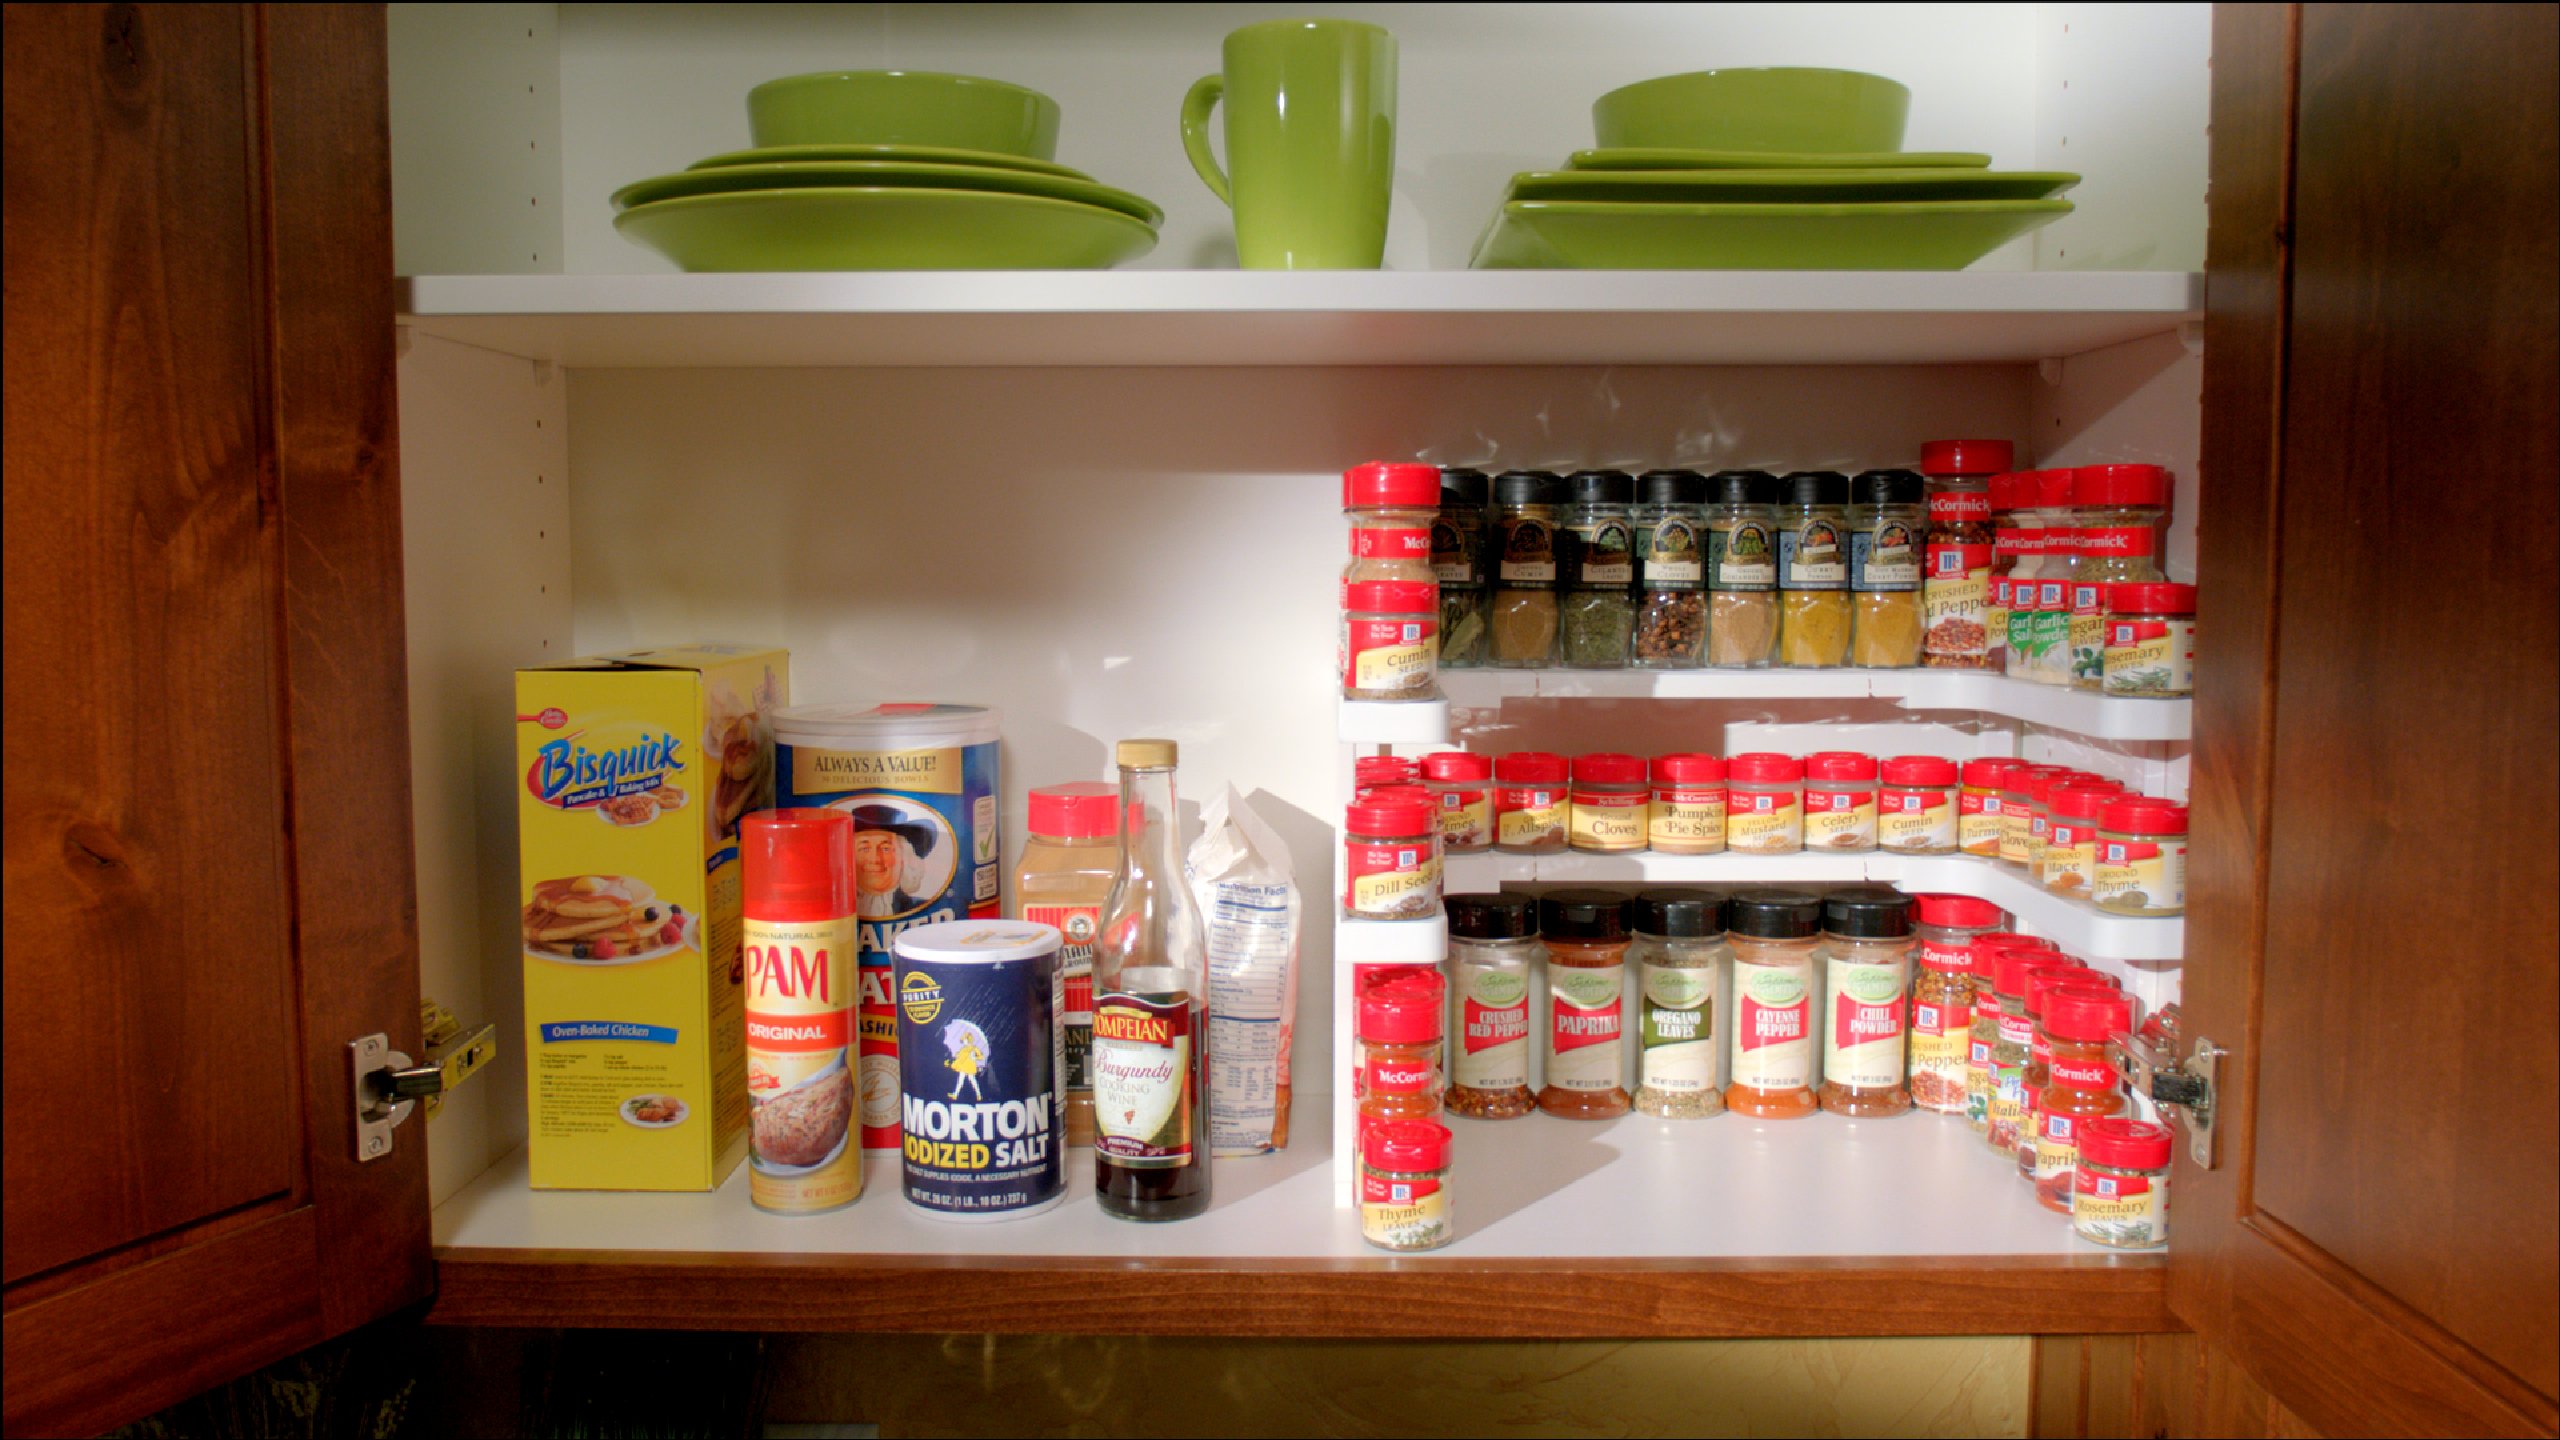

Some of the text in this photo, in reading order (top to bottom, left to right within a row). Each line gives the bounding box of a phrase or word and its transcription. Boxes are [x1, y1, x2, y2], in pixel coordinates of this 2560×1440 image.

[1939, 598, 1989, 617] Peppe
[2013, 629, 2032, 643] Sal
[538, 733, 686, 800] Bisquick
[815, 755, 937, 773] ALWAYS A VALUE!
[831, 774, 891, 785] DELICIOUS
[1592, 819, 1638, 836] Cloves
[1665, 820, 1690, 834] Pie
[1740, 820, 1787, 836] Mustard
[1820, 813, 1861, 828] Celery
[1892, 816, 1934, 830] Cumin
[2001, 830, 2030, 846] Clove
[1375, 879, 1400, 897] Dill
[2097, 878, 2141, 895] Thyme
[745, 944, 829, 1005] PAM
[1479, 1008, 1525, 1025] CRUSHED
[1651, 1010, 1702, 1025] OREGANO
[1755, 1008, 1800, 1023] CAYENNE
[1860, 1007, 1890, 1020] CHILI
[552, 1023, 649, 1038] Oven-Baked Chicken
[748, 1022, 828, 1041] ORIGINAL
[1094, 1013, 1169, 1041] OMPEIAN
[1468, 1020, 1528, 1038] RED PEPPE
[1558, 1014, 1619, 1036] PAPRIKA
[1657, 1023, 1697, 1038] LEAVES
[1755, 1022, 1800, 1037] PEPPER
[1850, 1018, 1897, 1034] POWDER
[1094, 1046, 1174, 1084] Burgundy
[1100, 1078, 1150, 1095] COOKING
[1107, 1091, 1137, 1105] WINE
[903, 1092, 1049, 1141] MORTON
[904, 1132, 1049, 1169] IODIZED SALT
[1378, 1204, 1426, 1223] Thyme
[2077, 1200, 2147, 1213] Rosemary
